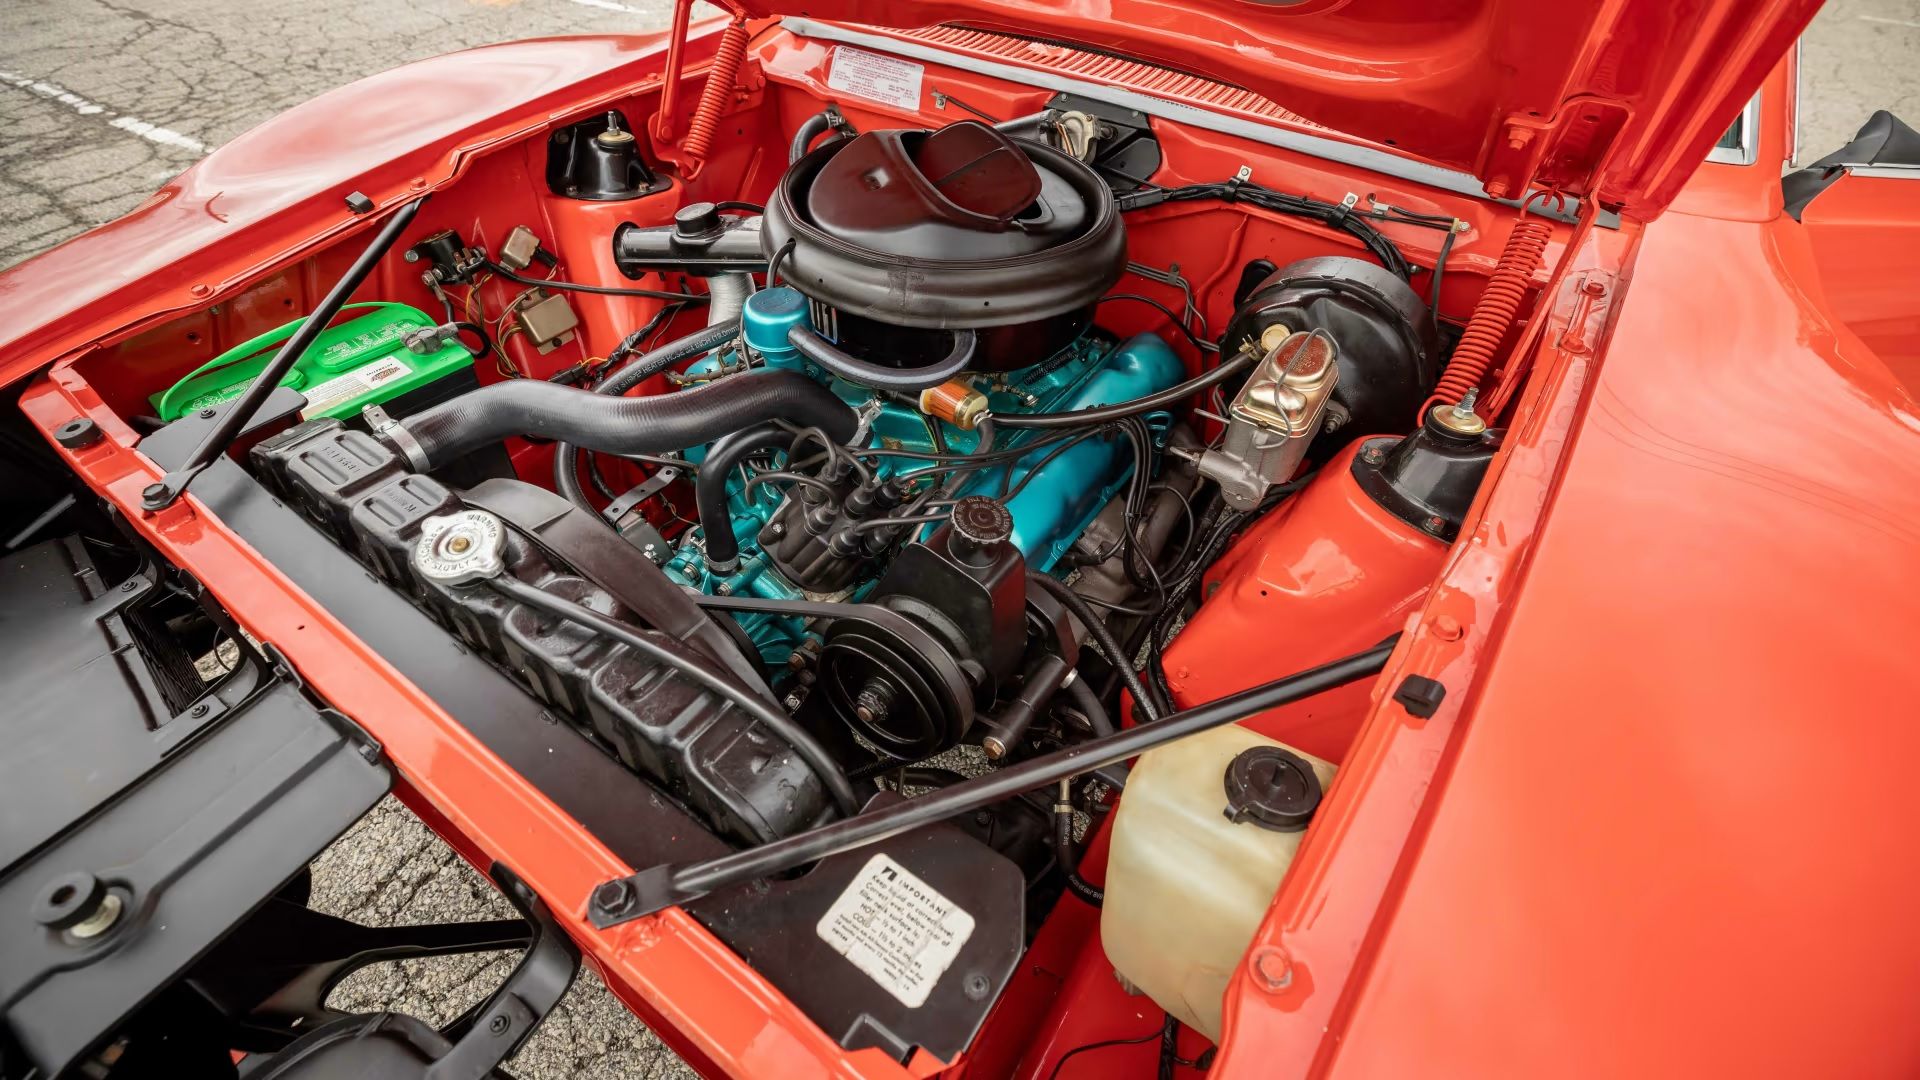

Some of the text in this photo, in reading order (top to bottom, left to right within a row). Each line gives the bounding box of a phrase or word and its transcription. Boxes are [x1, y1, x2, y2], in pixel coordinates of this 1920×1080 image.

[642, 357, 667, 373] HEATER
[667, 351, 685, 362] HOSE
[695, 337, 712, 349] INCH
[467, 514, 497, 538] WARNING
[432, 560, 469, 572] SLOWLY
[859, 889, 873, 902] filler
[889, 913, 911, 931] surface
[866, 882, 888, 901] Correct
[906, 912, 925, 929] below
[872, 875, 887, 888] Keep
[915, 908, 938, 926] correct
[899, 880, 947, 917] IMPORTANT
[860, 903, 875, 916] HOT
[902, 934, 915, 947] inch
